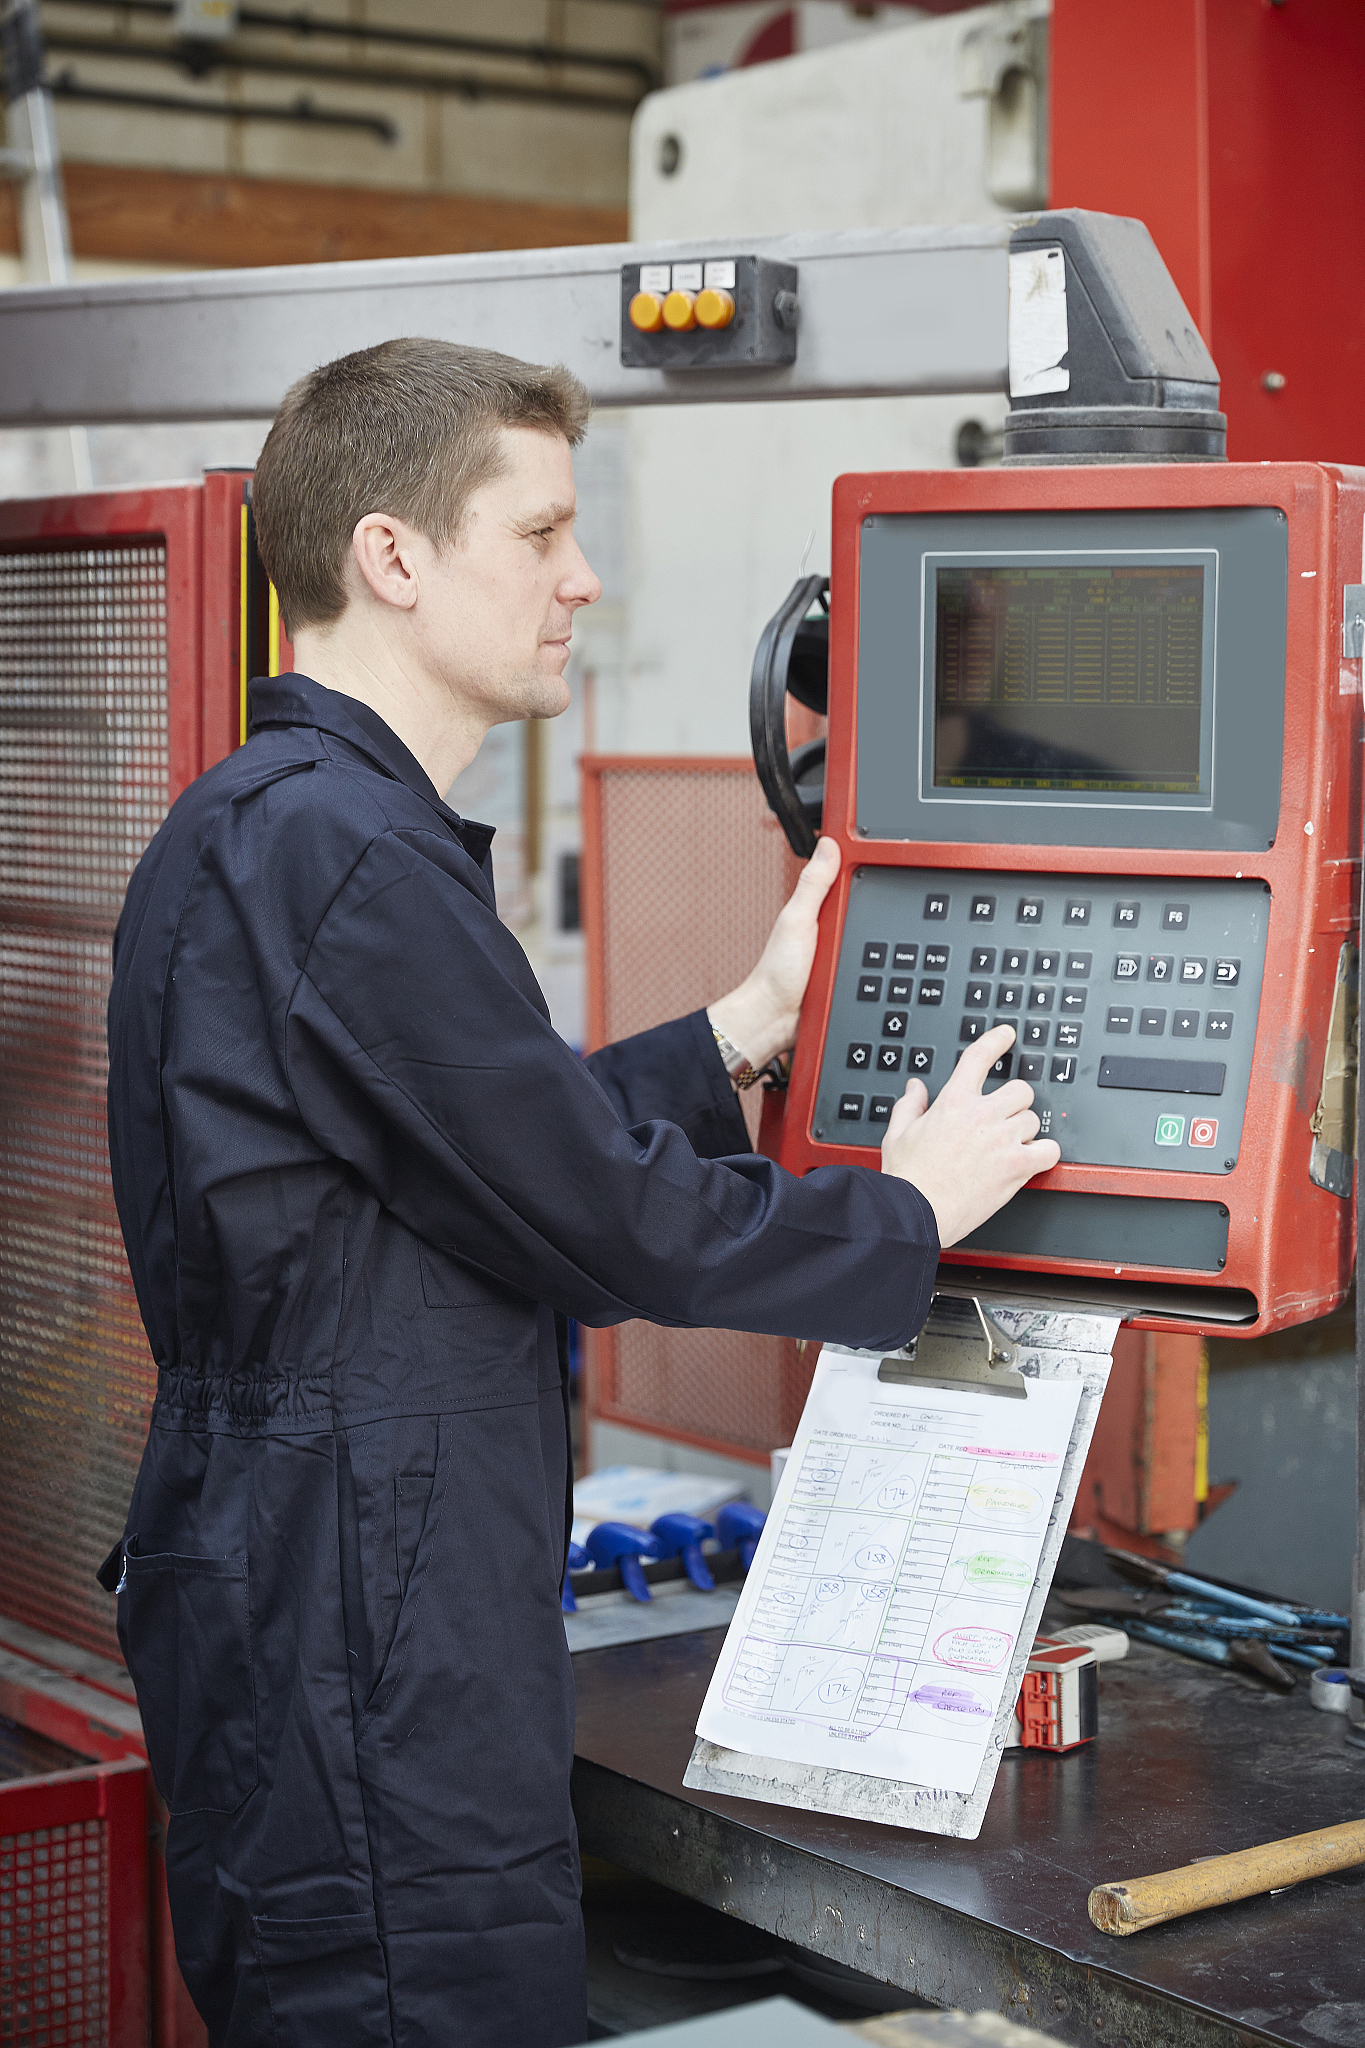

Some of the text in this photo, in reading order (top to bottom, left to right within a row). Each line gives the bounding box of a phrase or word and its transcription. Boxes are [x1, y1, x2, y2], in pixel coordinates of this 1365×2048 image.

[930, 901, 944, 913] F1
[975, 902, 991, 915] F2
[1023, 904, 1038, 917] F3
[1070, 906, 1086, 919] F4
[1119, 908, 1134, 921] F5
[1168, 910, 1183, 923] F6
[979, 954, 988, 967] 7
[1010, 956, 1019, 968] 8
[1042, 957, 1051, 970] 9
[1071, 960, 1086, 970] Esc
[973, 989, 983, 1001] 4
[1005, 990, 1014, 1003] 5
[1037, 992, 1046, 1005] 6
[969, 1023, 977, 1035] 1
[1031, 1027, 1041, 1039] 3
[995, 1060, 1003, 1072] 0
[874, 1410, 901, 1419] ORDERED
[870, 1420, 890, 1428] ORDER
[813, 1429, 828, 1437] DATE
[938, 1443, 954, 1451] DATE
[883, 1487, 909, 1501] 174
[867, 1550, 887, 1564] 158
[827, 1684, 852, 1698] 174
